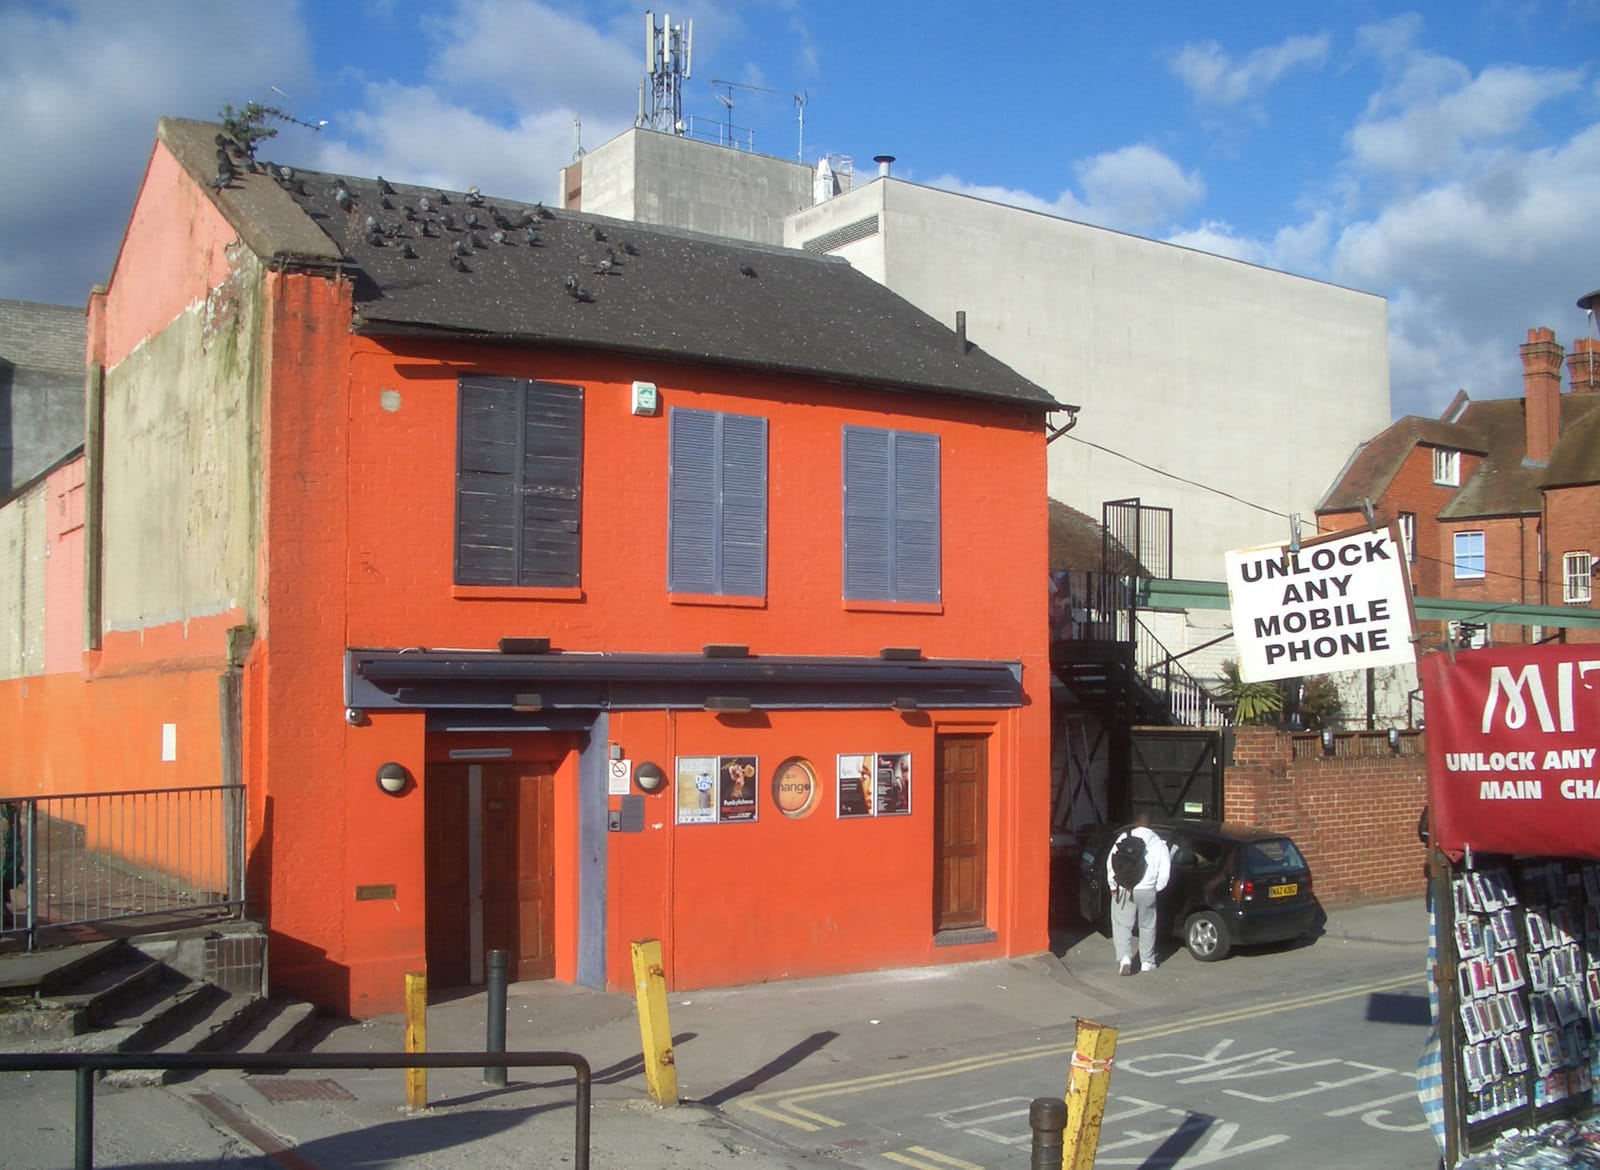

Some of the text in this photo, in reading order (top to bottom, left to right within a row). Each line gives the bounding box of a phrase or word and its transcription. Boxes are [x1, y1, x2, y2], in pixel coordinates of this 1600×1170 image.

[1241, 539, 1390, 582] UNLOCK
[1282, 574, 1352, 606] ANY
[1254, 599, 1390, 638] MOBILE
[1265, 629, 1390, 665] PHONE
[1446, 748, 1597, 771] UNLOCK ANY
[1480, 780, 1542, 799] MAIN
